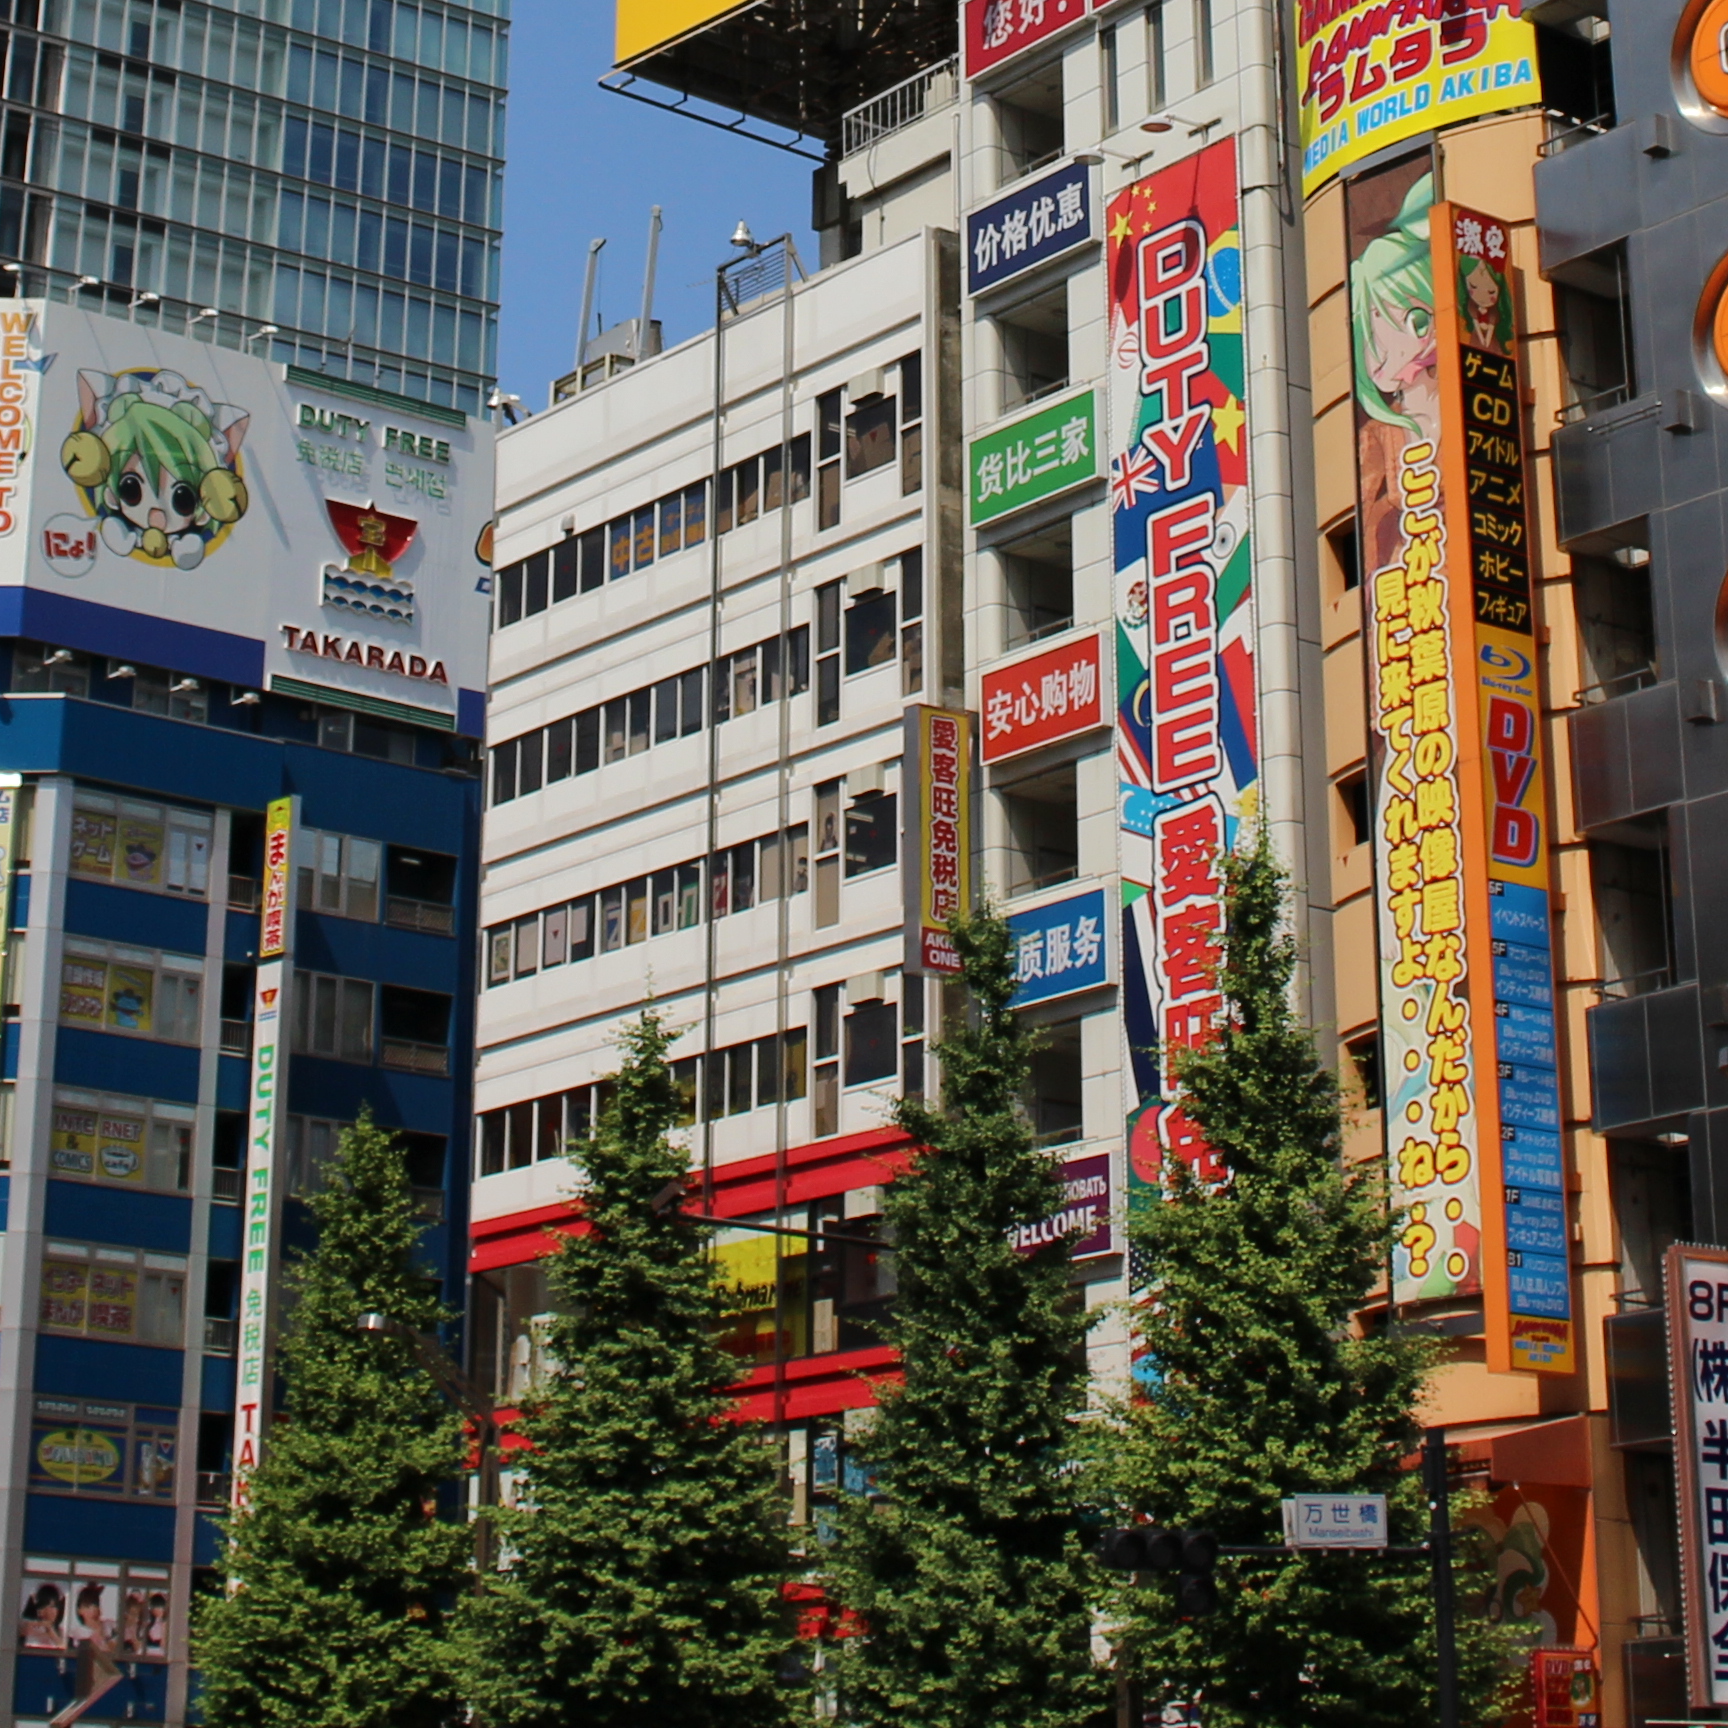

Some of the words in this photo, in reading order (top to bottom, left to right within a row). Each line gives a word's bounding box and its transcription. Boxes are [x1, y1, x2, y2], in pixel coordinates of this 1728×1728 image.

[1319, 12, 1487, 125] ラムタラ
[1303, 119, 1349, 174] MEDIA
[1357, 83, 1430, 137] WORLD
[1439, 59, 1532, 103] AKIBA
[974, 179, 1085, 275] 价格优惠
[1457, 217, 1507, 259] 激安
[1138, 220, 1211, 492] DUTY
[1466, 352, 1514, 391] ゲーム
[1472, 394, 1511, 427] CD
[297, 403, 371, 443] DUTY
[383, 425, 452, 466] FREE
[1468, 430, 1519, 466] アイドル
[296, 438, 364, 477] 免税店
[976, 417, 1090, 505] 货比三家
[1470, 468, 1522, 505] アニメ
[1474, 512, 1523, 546] コミック
[1478, 550, 1524, 581] ホビー
[1477, 589, 1528, 624] フィギュア
[280, 624, 450, 686] TAKARADA
[1146, 488, 1220, 792] FREE
[985, 651, 1099, 745] 安心购物
[1486, 694, 1540, 869] DVD
[264, 828, 289, 953] まんが喫茶
[929, 948, 962, 969] ONE
[1494, 1002, 1509, 1017] 4F
[1497, 1064, 1512, 1078] 3F
[253, 1044, 276, 1155] DUTY
[1500, 1126, 1515, 1141] 2F
[1505, 1188, 1520, 1203] 1F
[246, 1167, 270, 1275] FREE
[1507, 1252, 1522, 1266] B1
[1303, 1503, 1379, 1524] 万世橋
[1308, 1526, 1375, 1539] Manseibashi
